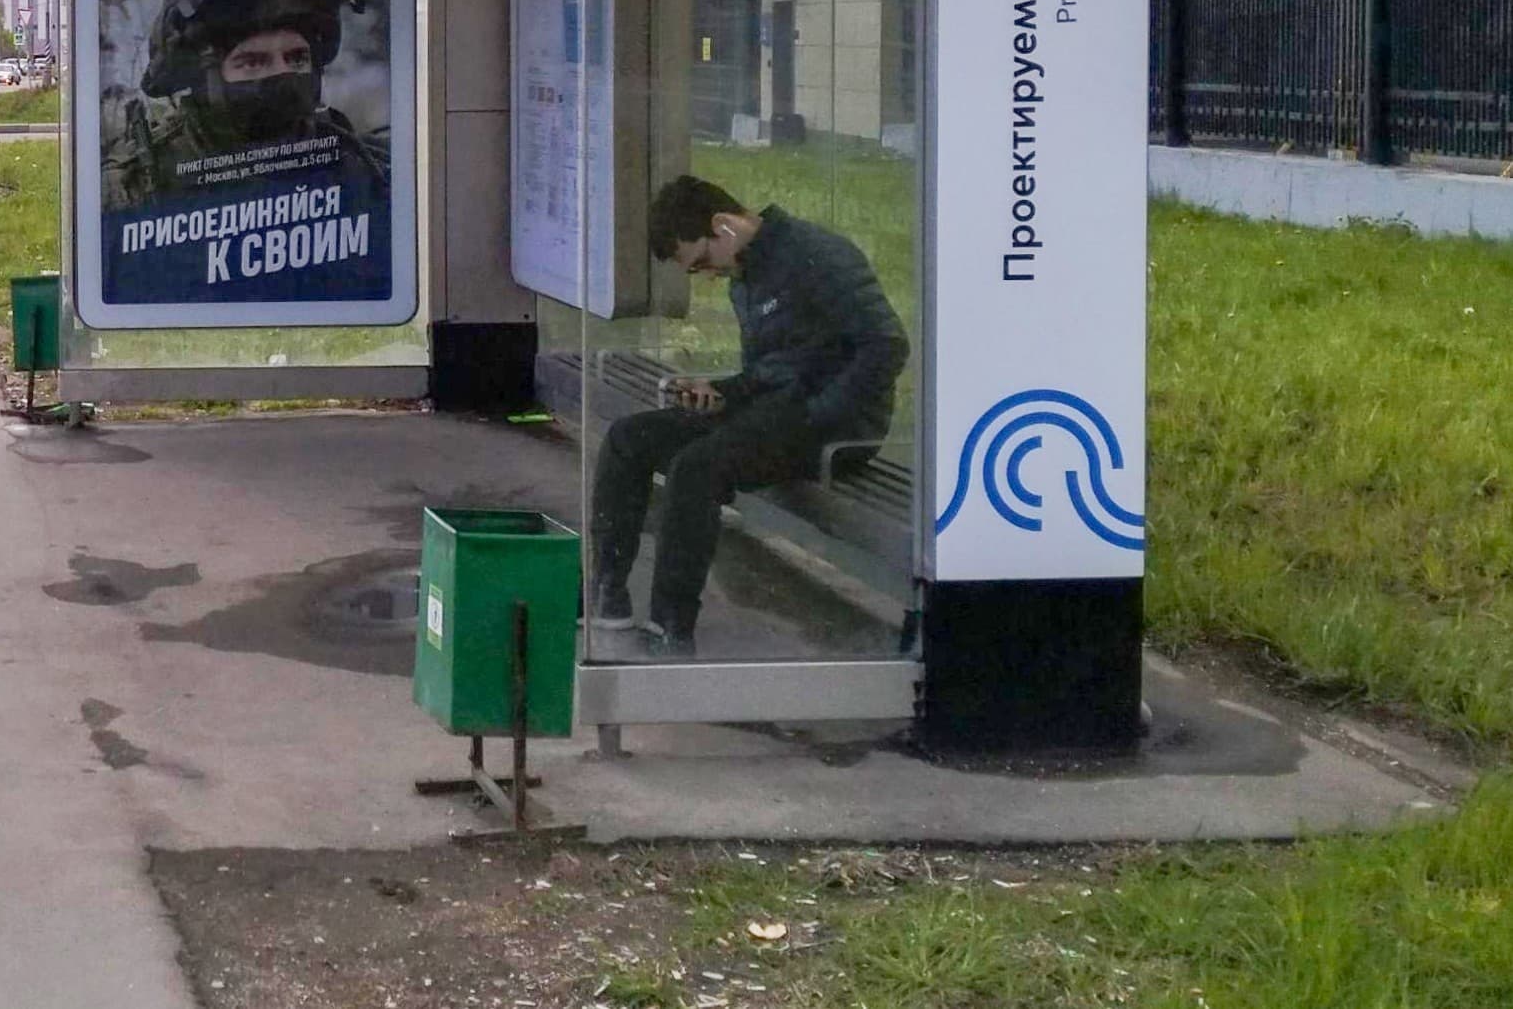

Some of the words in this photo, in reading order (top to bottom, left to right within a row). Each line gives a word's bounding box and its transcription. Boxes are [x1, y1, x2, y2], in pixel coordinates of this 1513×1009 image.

[280, 143, 292, 156] ПО
[122, 185, 341, 254] ПРИСОЕДИНЯЙСЯ
[207, 239, 231, 283] К
[241, 213, 370, 276] СВОИМ
